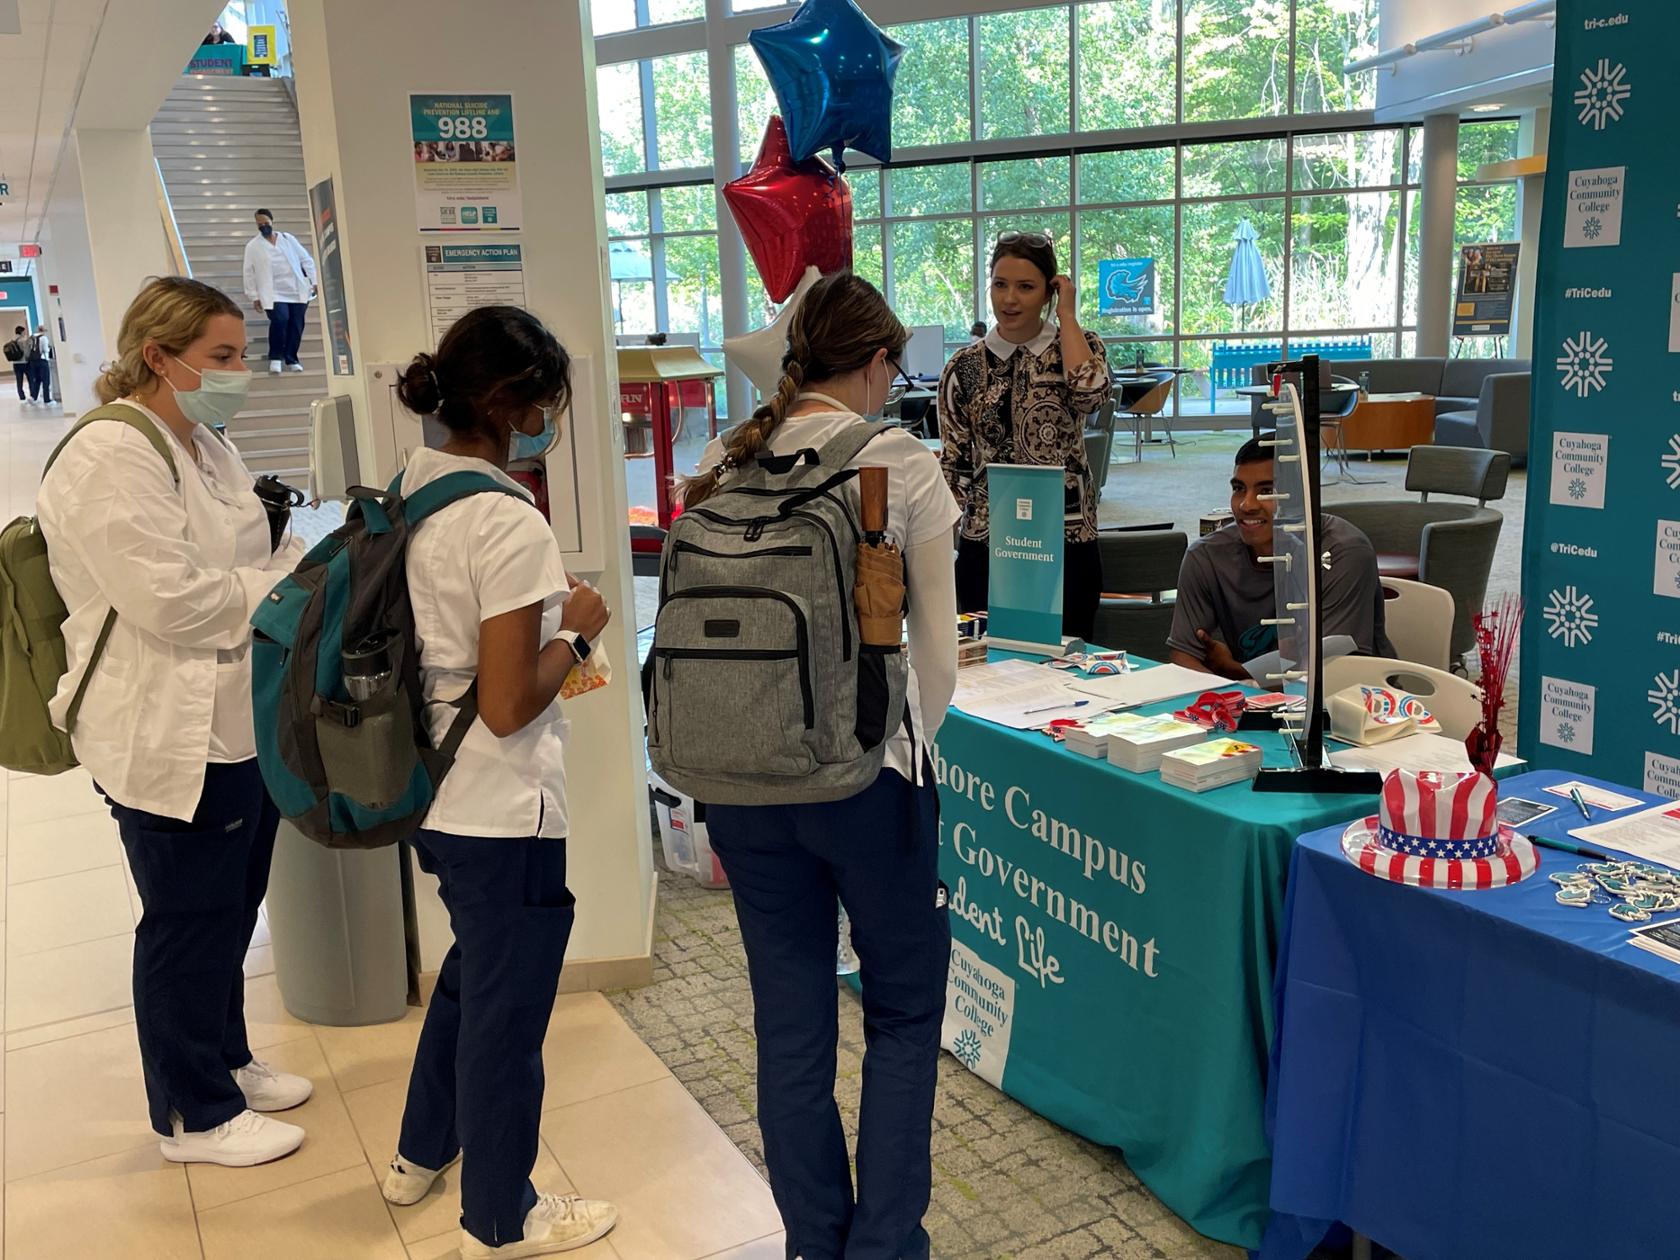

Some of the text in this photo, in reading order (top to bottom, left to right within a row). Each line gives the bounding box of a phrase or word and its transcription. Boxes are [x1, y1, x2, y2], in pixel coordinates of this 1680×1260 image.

[1584, 13, 1629, 30] tri-c.edu
[438, 117, 488, 139] 988
[1575, 175, 1618, 189] Cuyahoga
[1570, 187, 1620, 200] Community
[1578, 202, 1610, 213] College
[445, 249, 480, 257] EMERGENCY
[1565, 287, 1612, 299] #TriCedu
[1559, 438, 1601, 452] Cuyahoga
[1555, 450, 1604, 465] Community
[1563, 463, 1594, 476] College
[1005, 536, 1042, 548] Student
[995, 547, 1054, 562] Government
[1551, 542, 1598, 558] @TriCedu
[1547, 683, 1589, 700] Cuyahoga
[1544, 694, 1592, 713] Community
[1552, 707, 1582, 722] College
[1005, 786, 1146, 894] Campus
[953, 822, 1160, 977] Government
[1015, 915, 1065, 988] Life
[952, 949, 1005, 1000] Cuyahoga
[955, 995, 994, 1037] College
